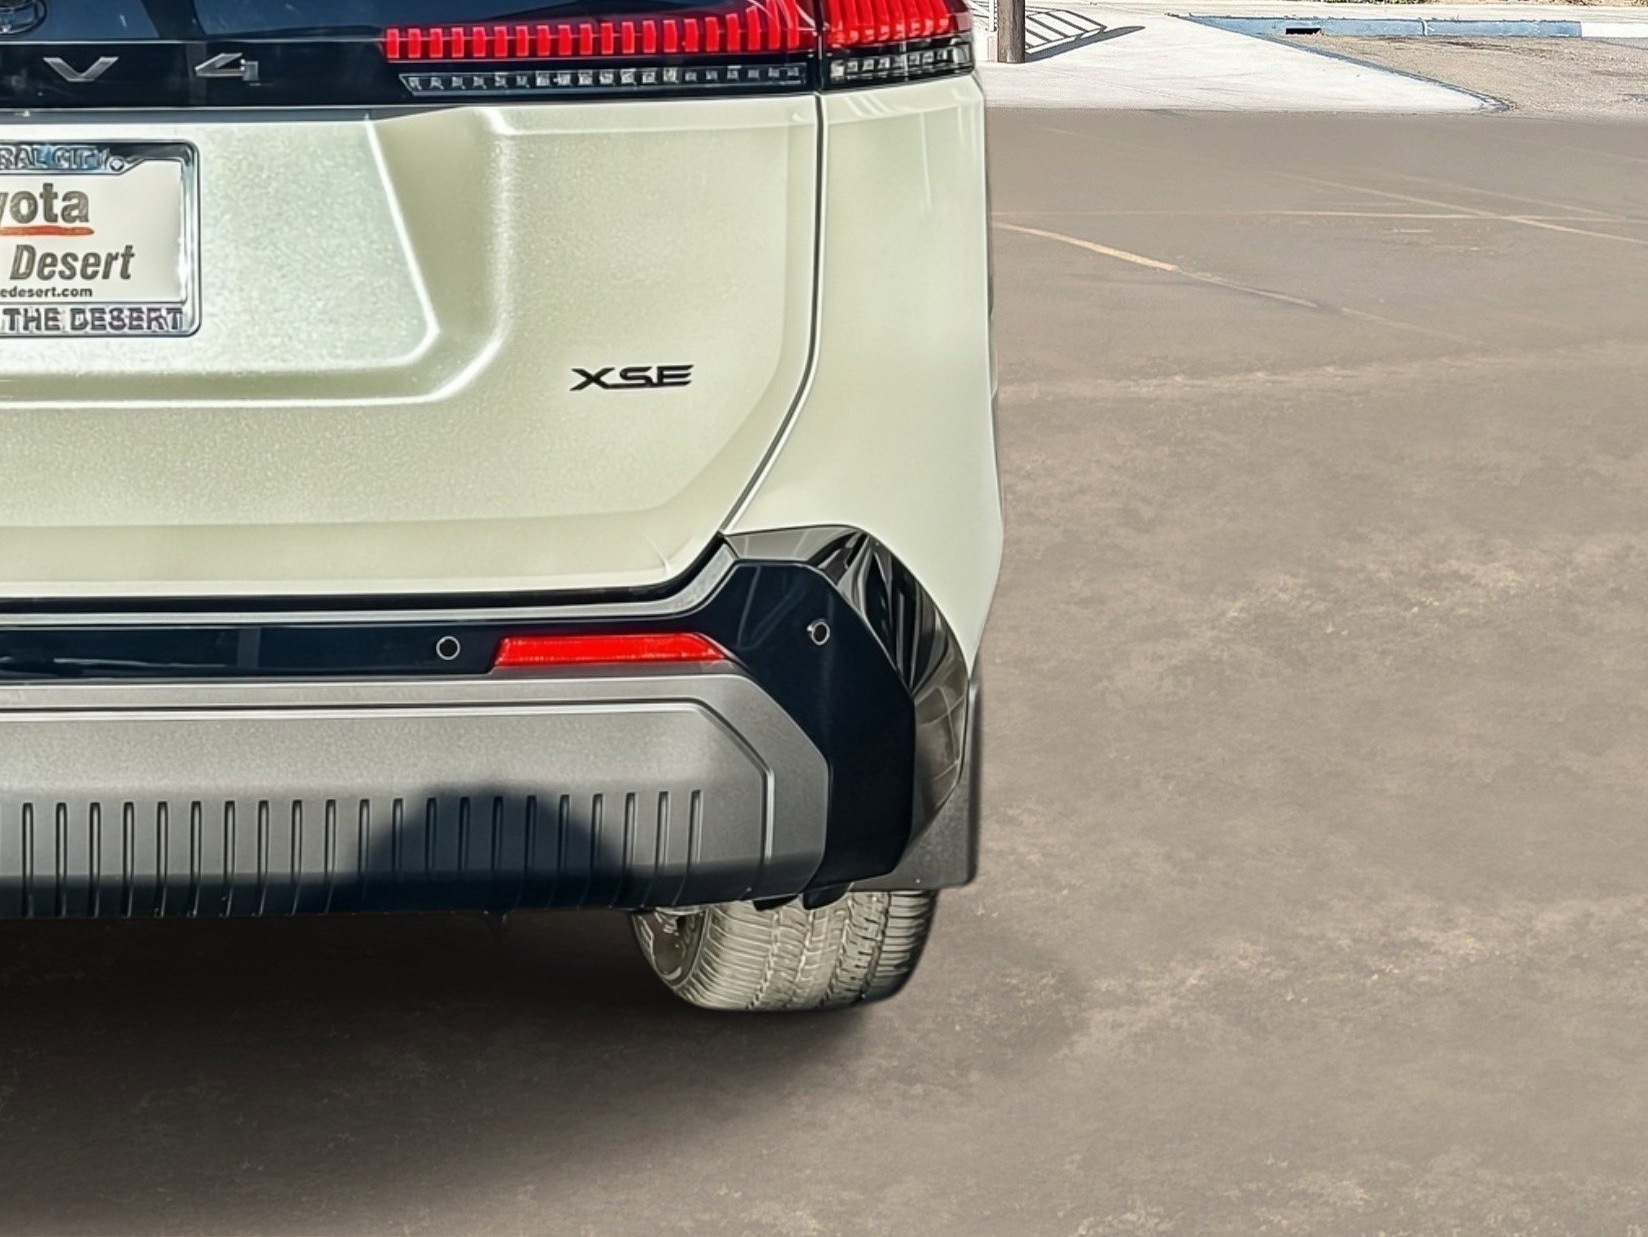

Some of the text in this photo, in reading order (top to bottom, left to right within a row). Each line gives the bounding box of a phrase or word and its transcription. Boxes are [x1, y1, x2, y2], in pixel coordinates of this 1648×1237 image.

[10, 244, 135, 281] Desert
[2, 309, 61, 332] THE
[69, 308, 184, 332] DESERT
[569, 364, 694, 391] XSE
